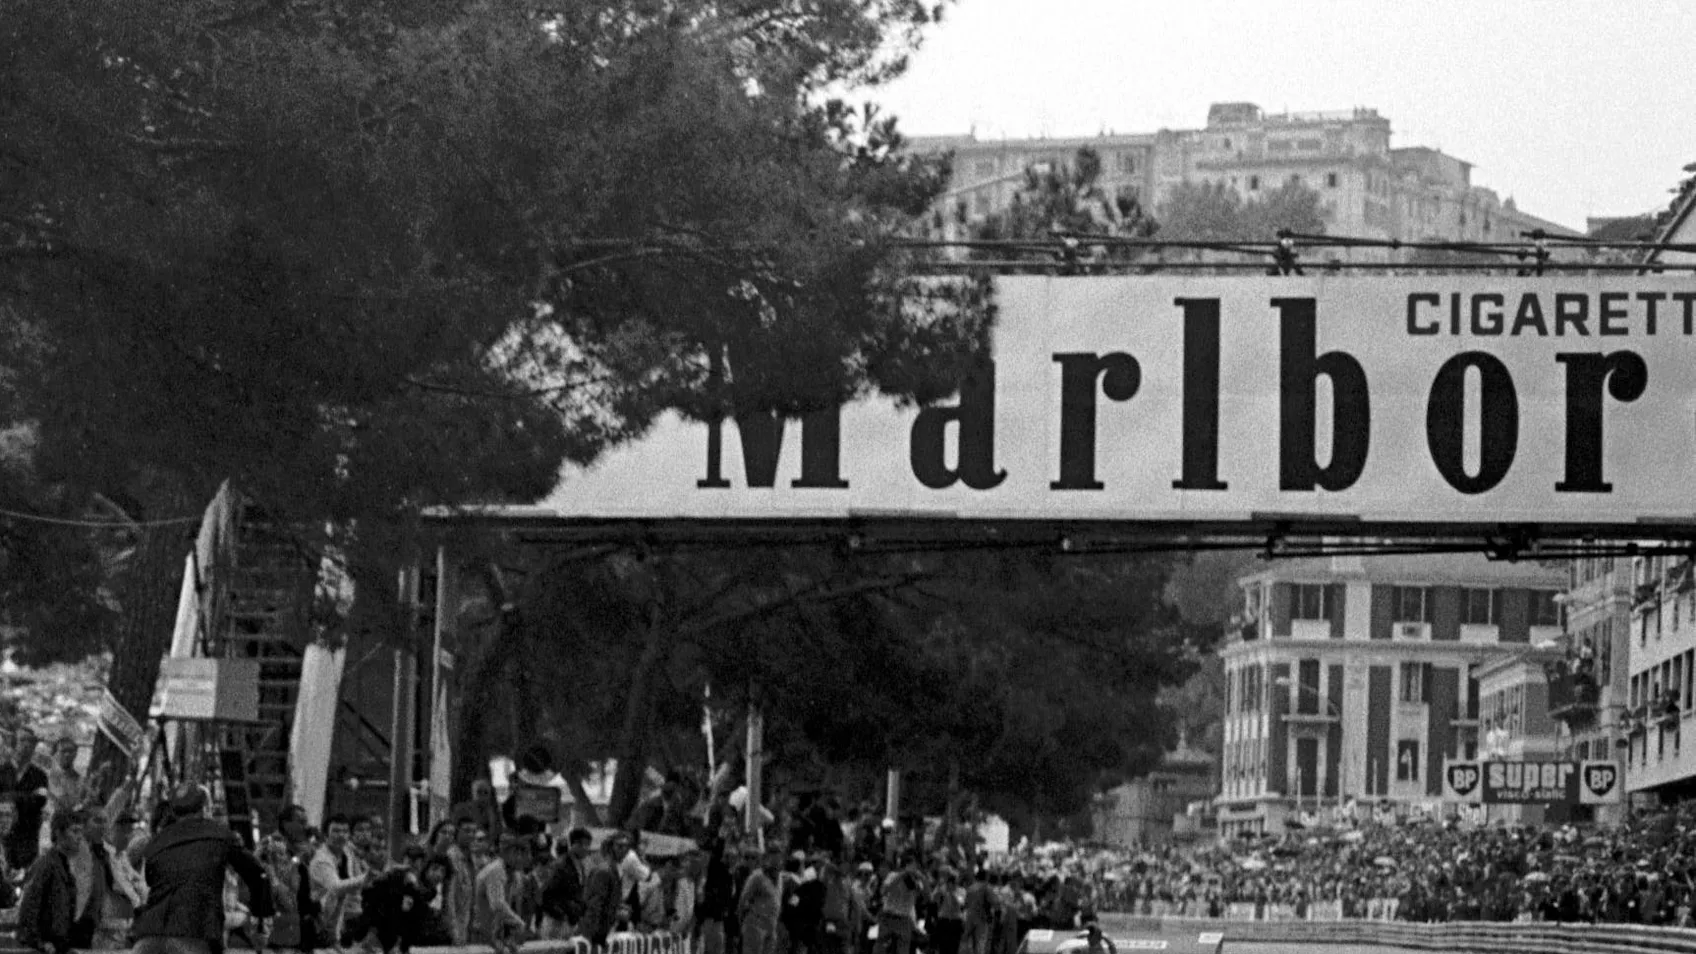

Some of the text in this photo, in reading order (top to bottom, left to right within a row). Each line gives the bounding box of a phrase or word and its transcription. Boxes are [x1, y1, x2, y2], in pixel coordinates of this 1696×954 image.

[1406, 291, 1696, 337] CIGARETT
[1454, 769, 1477, 789] BP
[1489, 763, 1574, 792] super
[1590, 769, 1614, 790] BP
